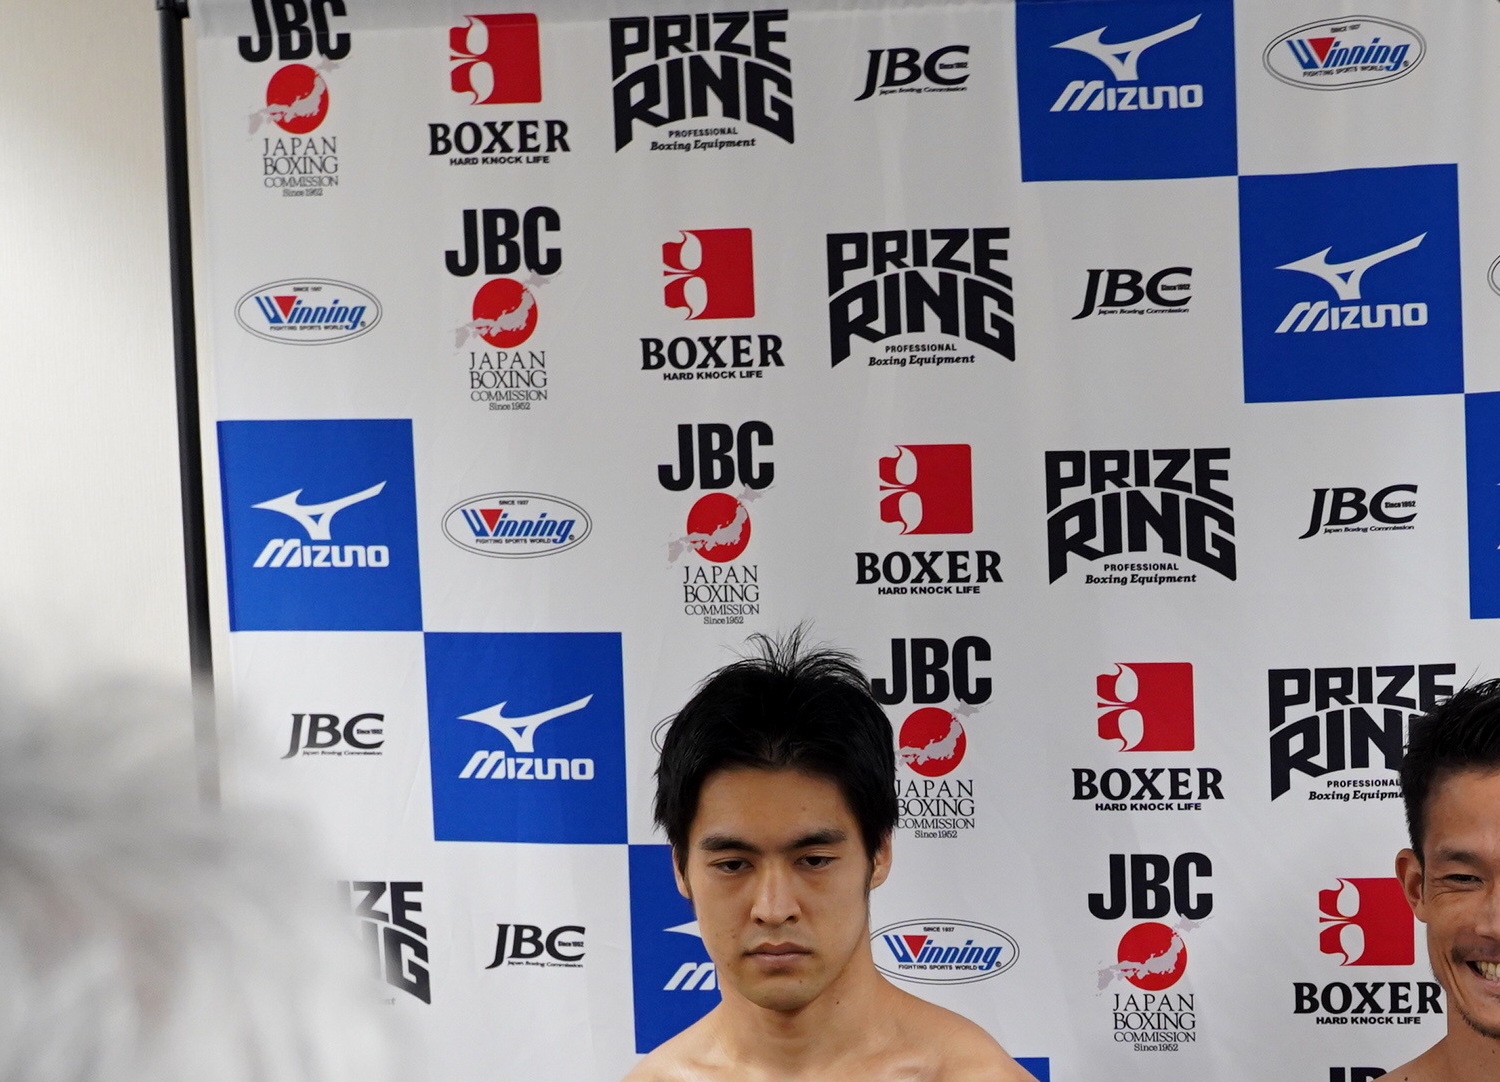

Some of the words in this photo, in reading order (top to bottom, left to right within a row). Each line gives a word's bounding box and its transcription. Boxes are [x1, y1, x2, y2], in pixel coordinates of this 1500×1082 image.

[237, 0, 350, 63] JBC
[610, 9, 791, 82] PRIZE
[1287, 37, 1409, 70] Winning
[855, 45, 969, 101] JBC
[613, 54, 794, 153] RING
[264, 136, 336, 156] JAPAN
[428, 120, 572, 155] BOXER
[264, 156, 338, 175] BOXING
[450, 157, 479, 166] HARD
[482, 156, 523, 165] KNOCK
[526, 155, 550, 164] LIFE
[443, 206, 561, 277] JBC
[827, 226, 1011, 297] PRIZE
[1072, 267, 1193, 320] JBC
[254, 296, 366, 330] Winning
[829, 271, 1014, 368] RING
[469, 351, 544, 370] JAPAN
[641, 335, 785, 370] BOXER
[867, 356, 908, 367] Boxing
[907, 355, 975, 366] Equipment
[885, 344, 957, 353] PROFESSIONAL
[469, 370, 546, 389] BOXING
[664, 372, 693, 381] HARD
[695, 371, 736, 380] KNOCK
[740, 370, 763, 379] LIFE
[470, 390, 546, 401] COMMISSION
[659, 421, 774, 491] JBC
[1045, 448, 1233, 514] PRIZE
[460, 508, 574, 544] Winning
[1298, 484, 1416, 540] JBC
[1047, 490, 1236, 584] RING
[683, 565, 757, 584] JAPAN
[855, 551, 1003, 584] BOXER
[1085, 575, 1127, 585] Boxing
[1127, 574, 1196, 585] Equipment
[1104, 563, 1179, 571] PROFESSIONAL
[684, 584, 759, 603] BOXING
[878, 587, 908, 595] HARD
[910, 586, 952, 594] KNOCK
[956, 586, 980, 594] LIFE
[685, 604, 760, 615] COMMISSION
[871, 636, 990, 705] JBC
[1269, 664, 1456, 732] PRIZE
[280, 713, 384, 760] JBC
[1268, 708, 1415, 802] RIN
[895, 780, 972, 798] JAPAN
[1072, 768, 1226, 800] BOXER
[1308, 791, 1350, 802] Boxing
[1096, 803, 1127, 811] HARD
[1130, 803, 1173, 811] KNOCK
[1177, 803, 1202, 811] LIFE
[1088, 852, 1213, 920] JBC
[486, 924, 584, 969] JBC
[883, 935, 1001, 970] Winning
[1113, 994, 1193, 1011] JAPAN
[1294, 982, 1445, 1014] BOXER
[1113, 1012, 1195, 1030] BOXING
[1114, 1032, 1195, 1042] COMMISSION
[1317, 1016, 1347, 1024] HARD
[1350, 1016, 1393, 1025] KNOCK
[1397, 1016, 1421, 1024] LIFE
